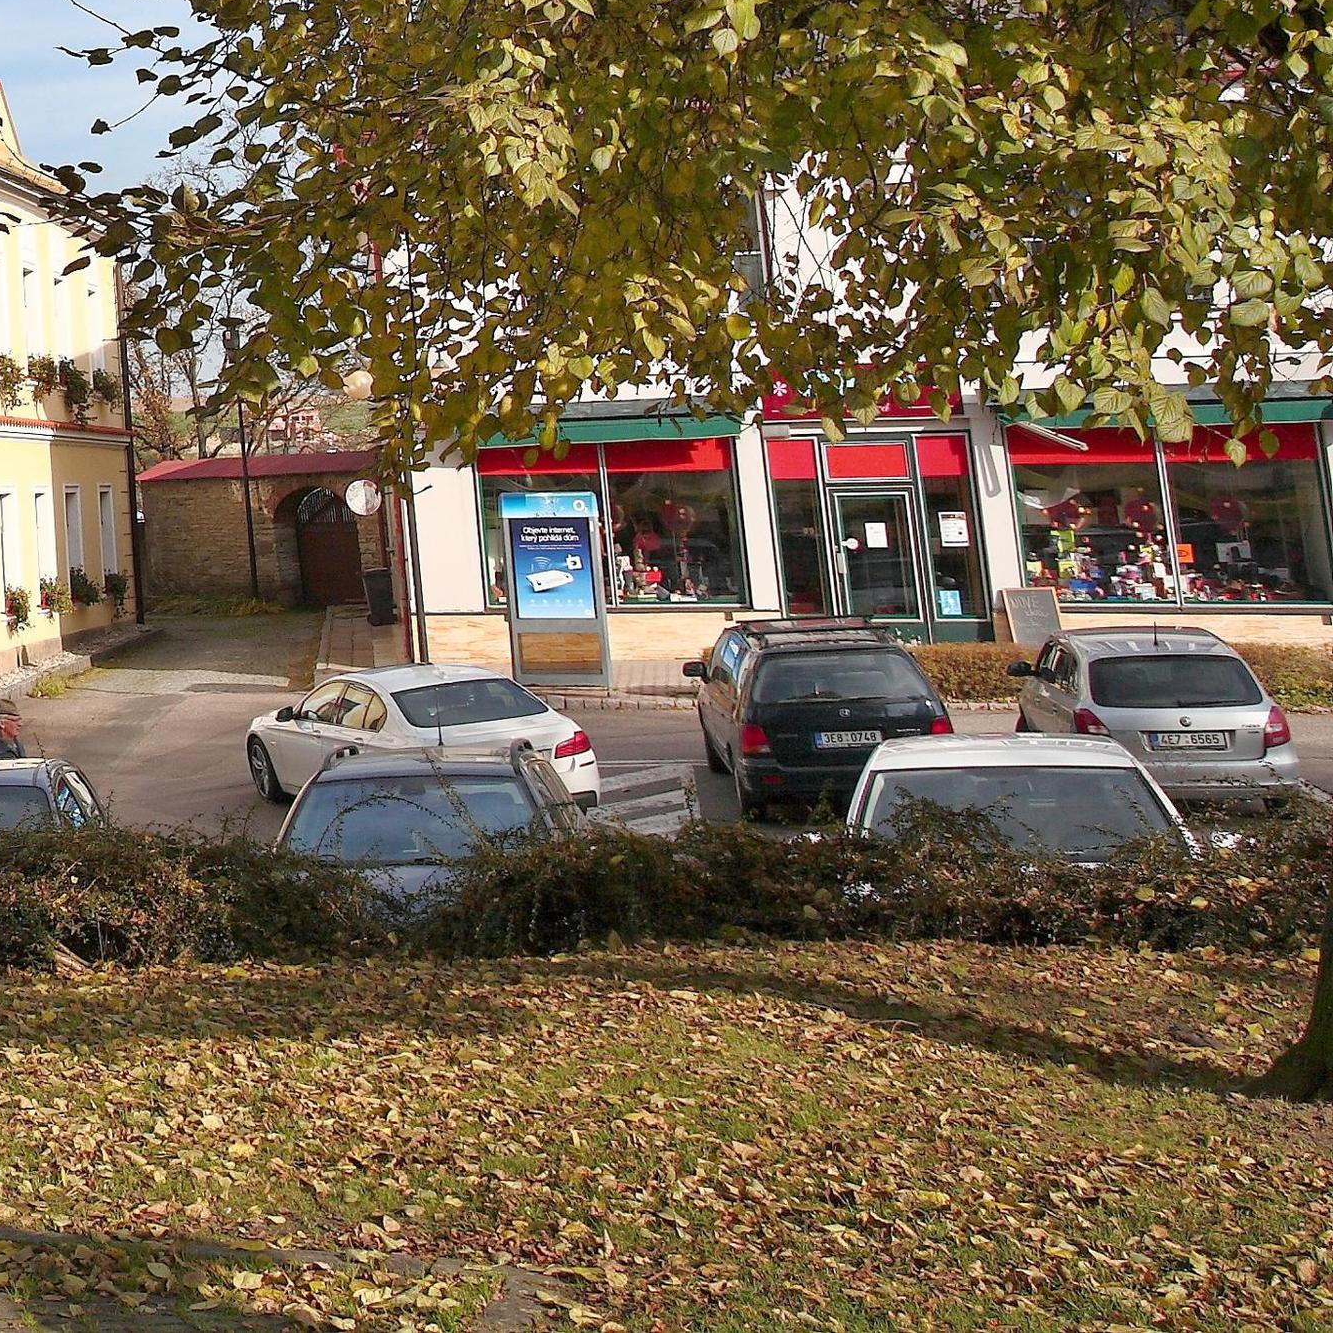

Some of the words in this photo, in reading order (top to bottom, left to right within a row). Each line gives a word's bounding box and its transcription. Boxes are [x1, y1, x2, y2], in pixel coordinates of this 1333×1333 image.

[522, 526, 548, 536] Objevte
[824, 732, 844, 744] 3E8
[1161, 734, 1181, 745] 4E7
[1190, 733, 1220, 745] 6565
